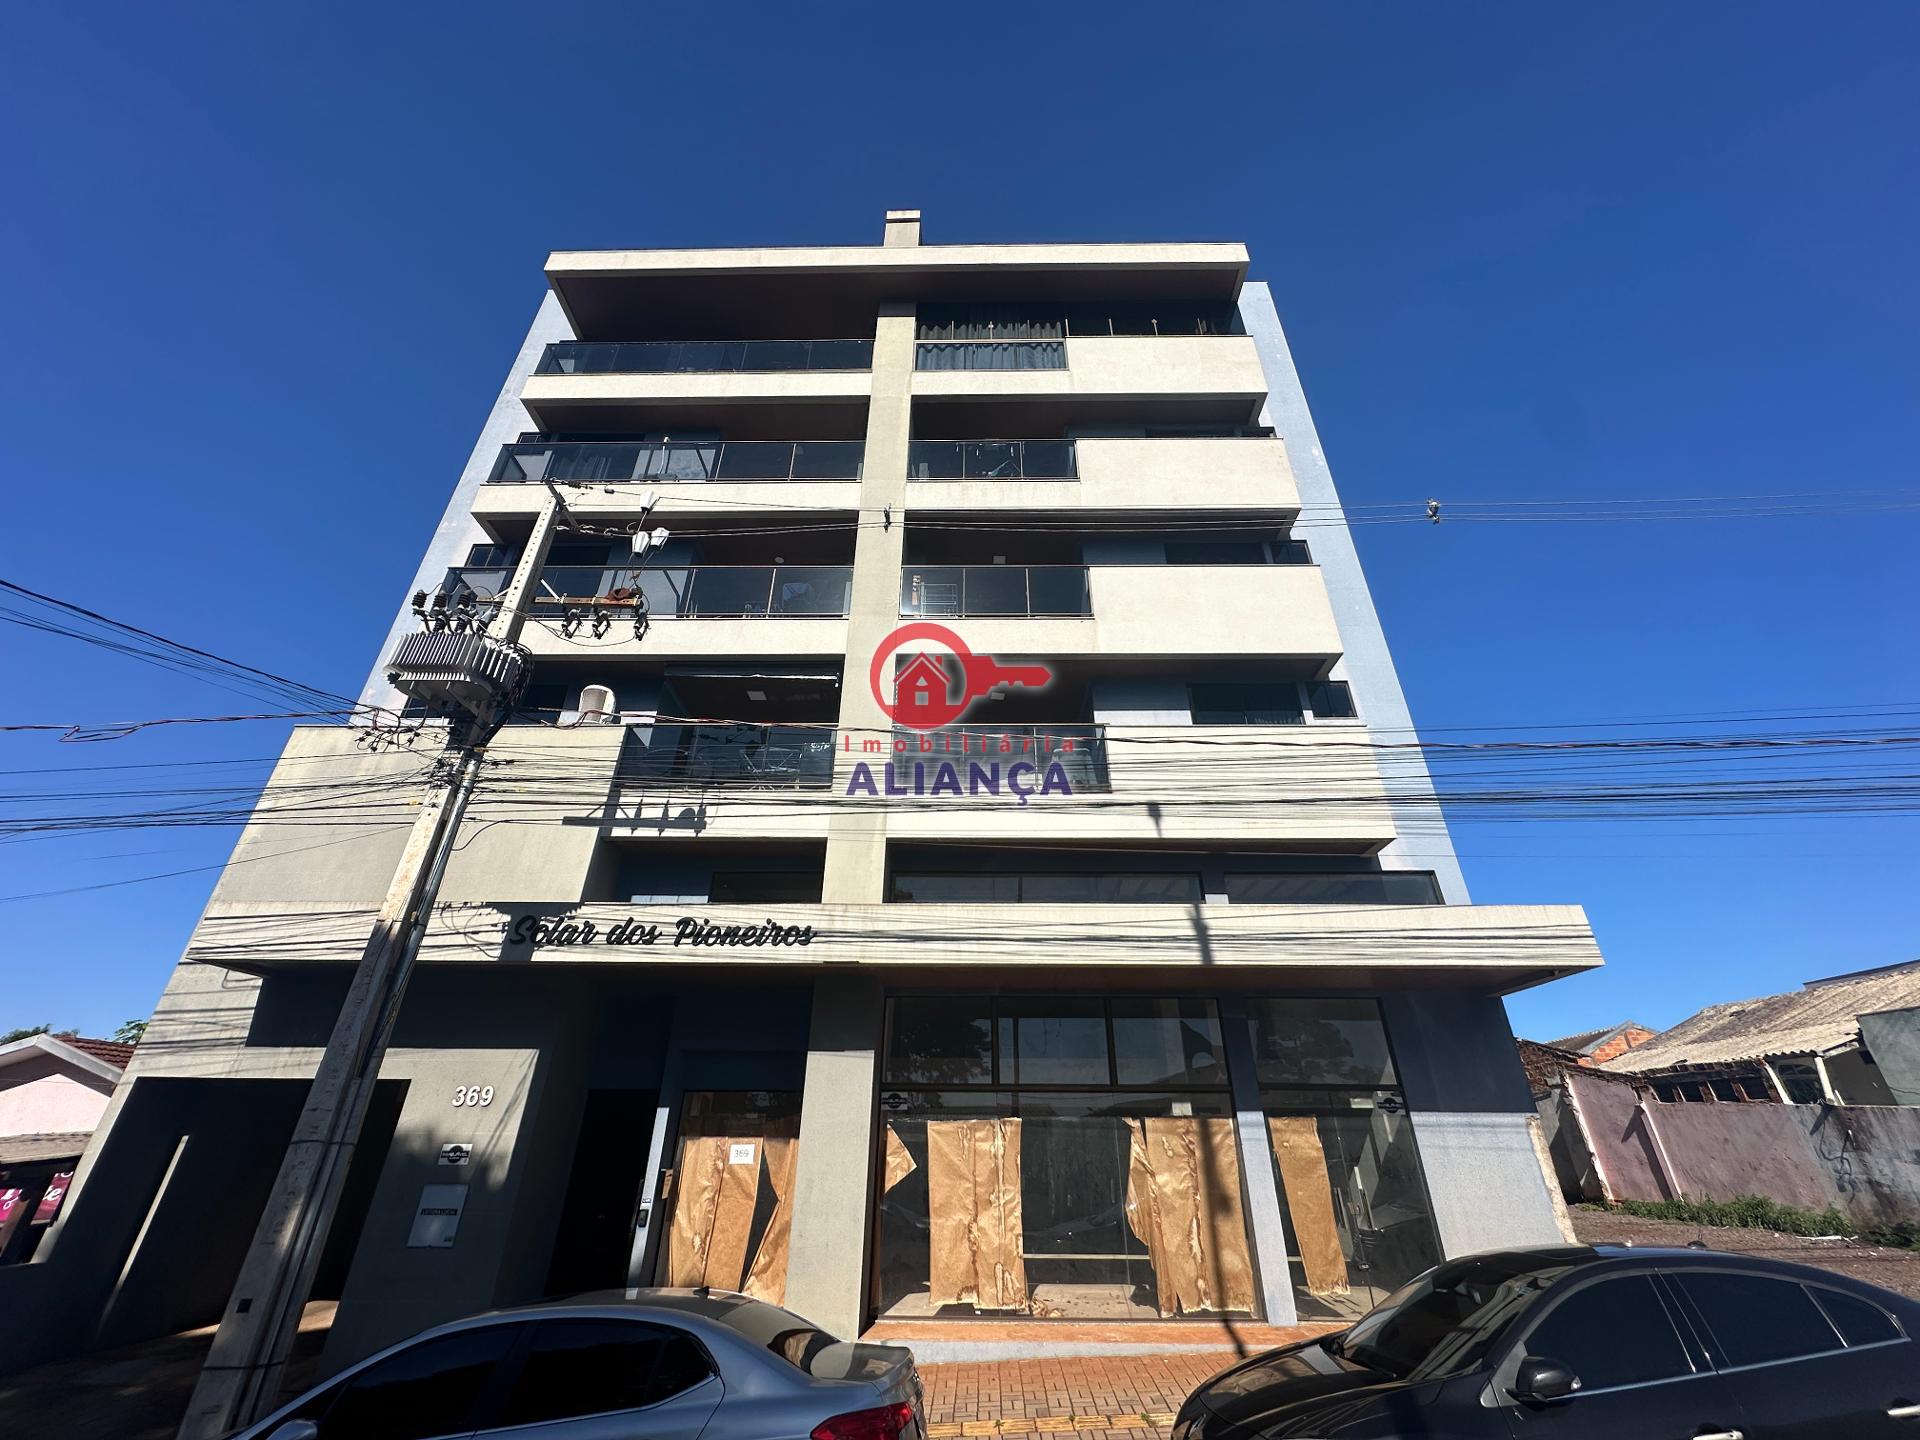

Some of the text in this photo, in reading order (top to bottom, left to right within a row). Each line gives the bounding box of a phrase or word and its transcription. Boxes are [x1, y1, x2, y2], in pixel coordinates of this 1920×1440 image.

[510, 914, 817, 947] Solar dos Pioneiros
[451, 1085, 495, 1108] 369
